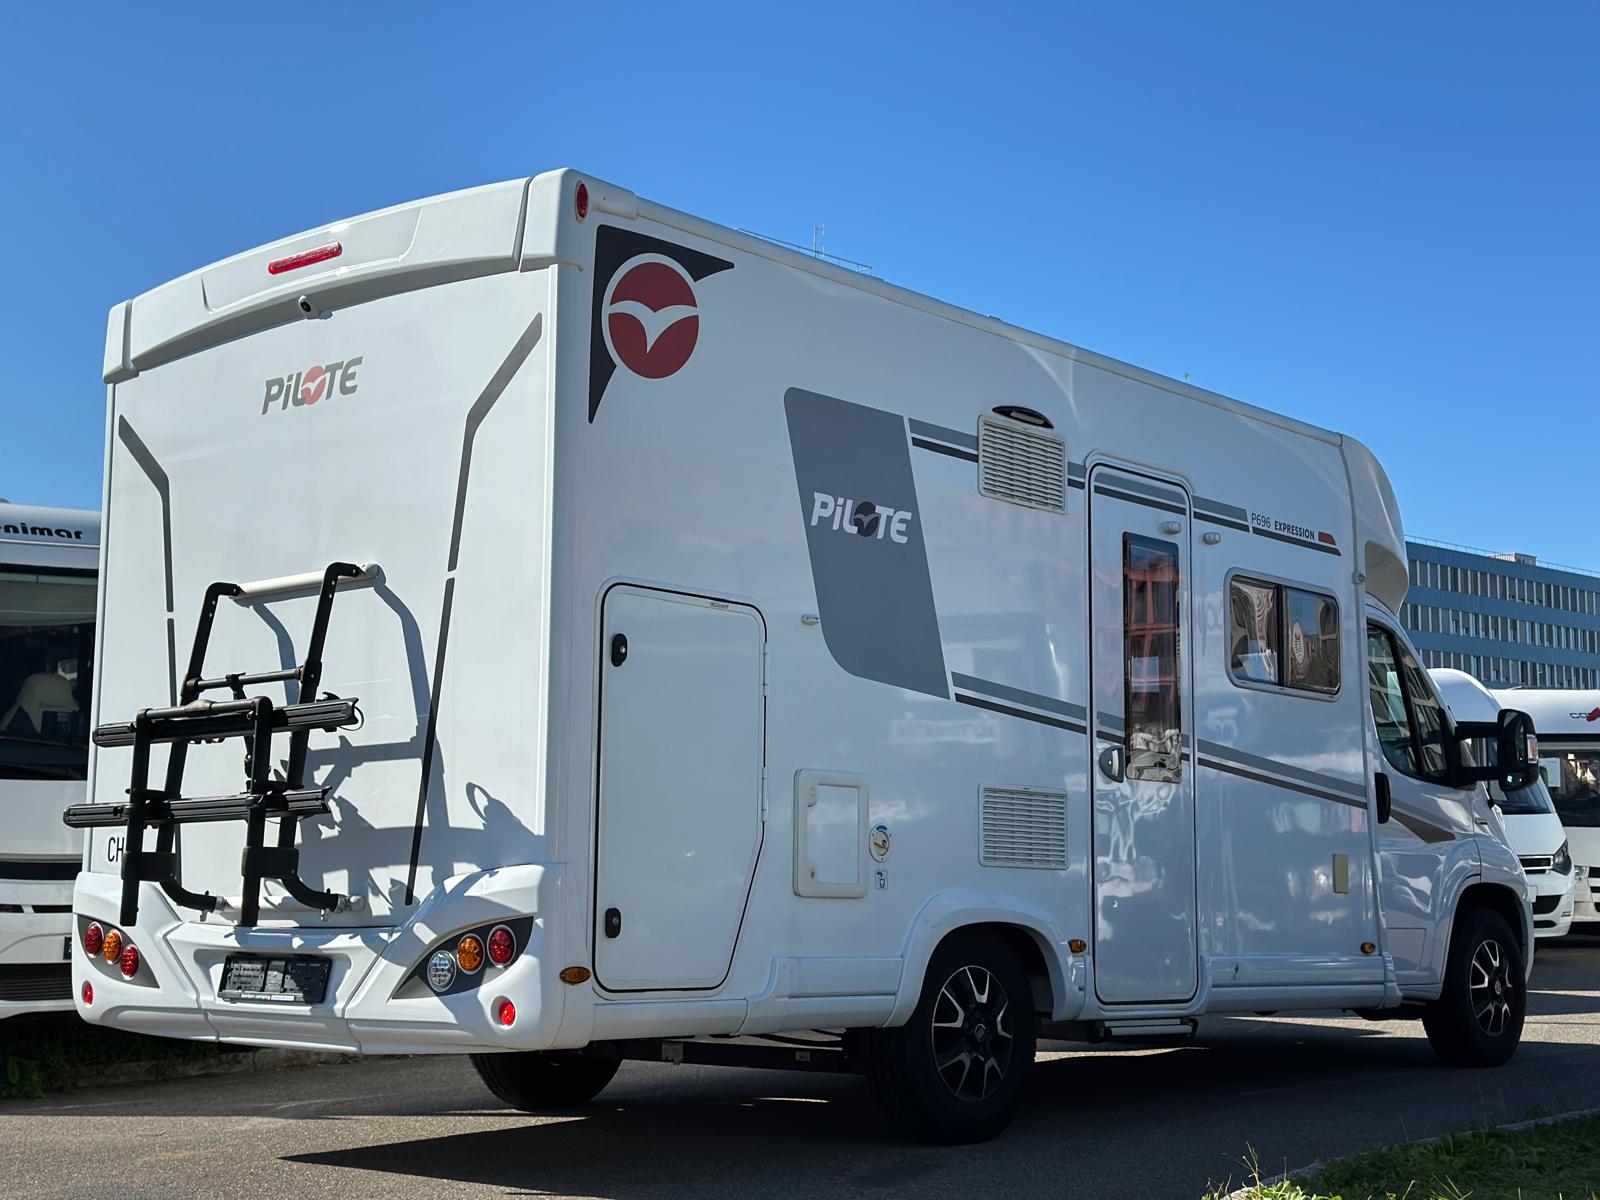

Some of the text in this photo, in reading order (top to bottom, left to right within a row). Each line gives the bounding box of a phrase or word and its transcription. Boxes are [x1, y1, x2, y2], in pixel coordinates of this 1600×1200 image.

[0, 522, 82, 540] nimar
[1251, 512, 1315, 541] P696 EXPRESSION
